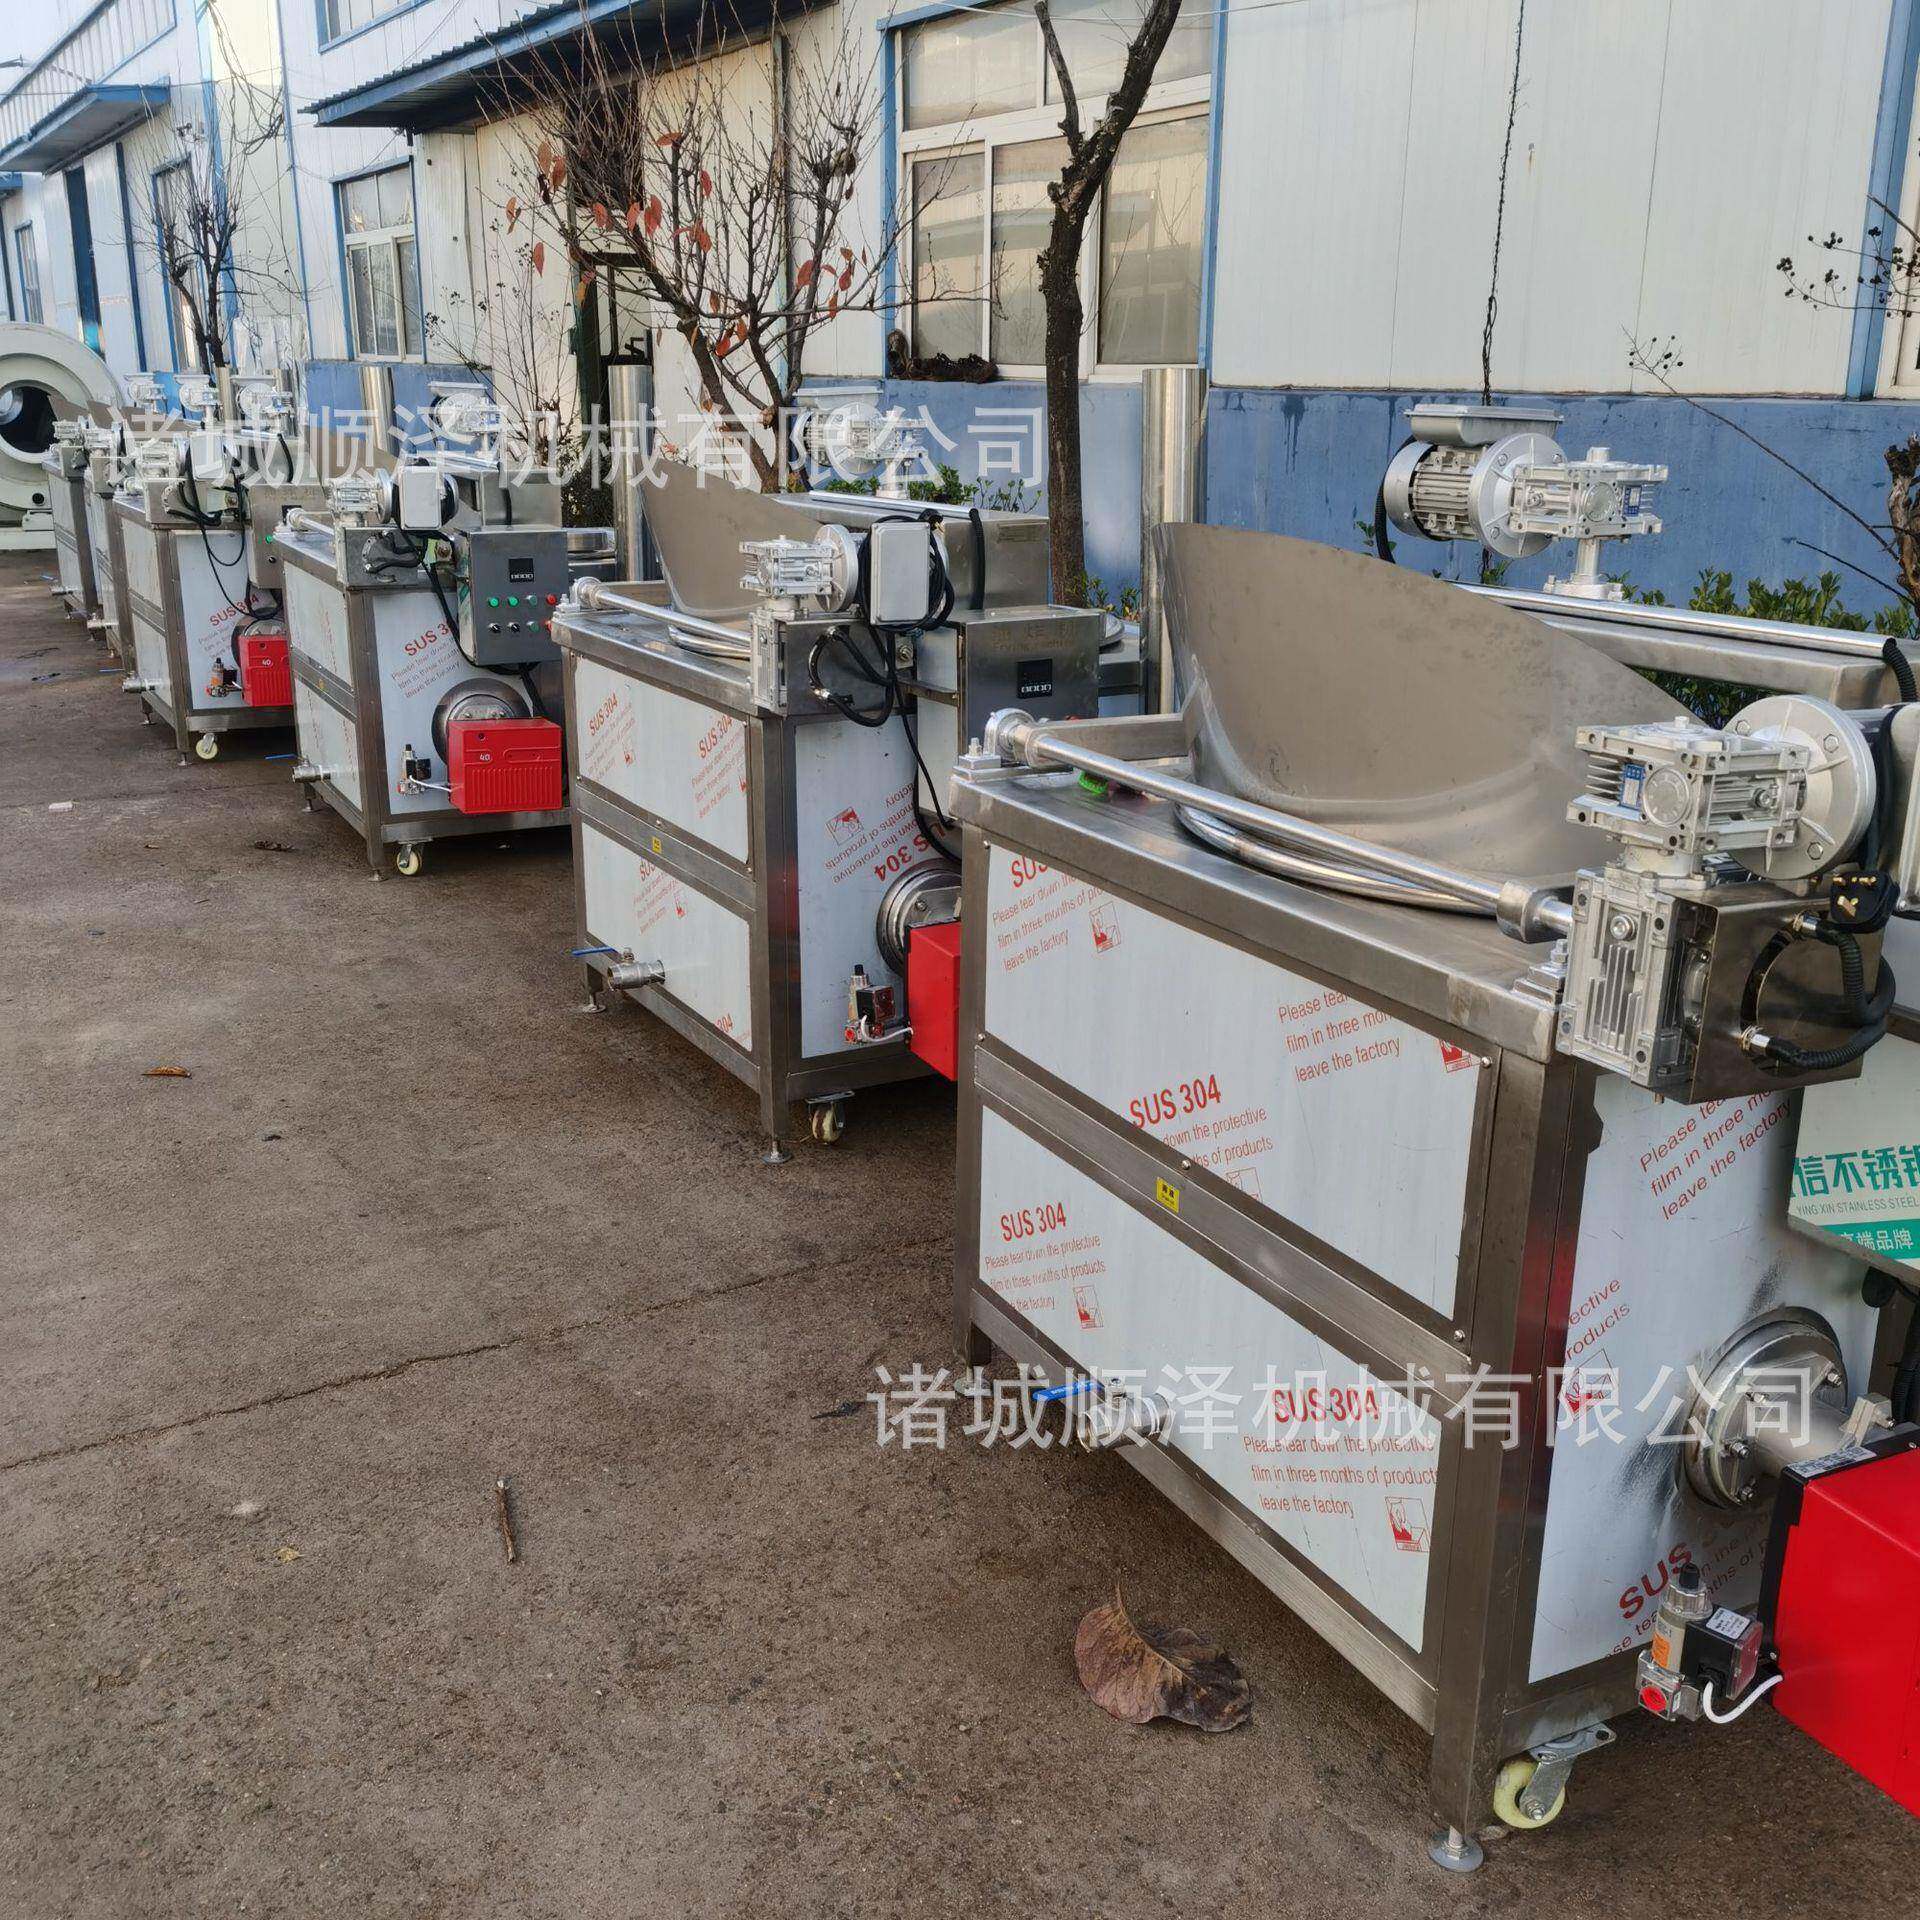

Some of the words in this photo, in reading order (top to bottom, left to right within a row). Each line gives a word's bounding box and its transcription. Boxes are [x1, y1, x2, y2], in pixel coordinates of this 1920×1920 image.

[404, 629, 438, 656] SUS
[589, 707, 606, 737] SUS
[698, 727, 718, 759] SUS
[885, 782, 914, 809] actory
[874, 844, 914, 883] 304
[992, 901, 1024, 928] Please
[1003, 952, 1025, 972] leave
[1025, 943, 1040, 960] the
[1278, 997, 1321, 1024] Please
[1286, 1034, 1310, 1053] film
[1312, 1027, 1324, 1046] in
[1326, 1016, 1360, 1041] three
[1295, 1059, 1330, 1083] leave
[1331, 1051, 1353, 1072] the
[1355, 1036, 1401, 1064] factory
[1130, 1088, 1177, 1129] SUS
[1179, 1074, 1222, 1114] 304
[1193, 1122, 1211, 1140] the
[1213, 1105, 1268, 1140] protective
[1211, 1146, 1223, 1166] of
[1224, 1134, 1274, 1164] products
[1640, 1117, 1698, 1174] Please
[1650, 1164, 1683, 1198] film
[1683, 1148, 1702, 1169] in
[1702, 1108, 1745, 1151] three
[1661, 1175, 1708, 1221] leave
[1709, 1149, 1737, 1178] the
[1738, 1097, 1792, 1153] factory
[1001, 1208, 1035, 1242] SUS
[1036, 1201, 1067, 1233] 304
[1796, 1203, 1819, 1217] YING
[1819, 1202, 1835, 1215] XIN
[1836, 1198, 1888, 1214] STAINLESS
[1888, 1195, 1920, 1210] STEEL
[1070, 1258, 1107, 1281] products
[1568, 1279, 1621, 1326] ective
[1565, 1303, 1631, 1361] roducts
[1273, 1388, 1327, 1423] SUS
[1329, 1387, 1380, 1422] 304
[1243, 1435, 1282, 1454] Please
[1344, 1433, 1364, 1454] the
[1368, 1435, 1435, 1457] protective
[1252, 1464, 1272, 1483] film
[1273, 1465, 1285, 1483] in
[1286, 1464, 1317, 1484] three
[1319, 1466, 1365, 1485] months
[1366, 1466, 1380, 1484] of
[1259, 1493, 1290, 1512] leave
[1291, 1494, 1312, 1513] the
[1312, 1494, 1355, 1519] factory
[1618, 1541, 1693, 1620] SUS
